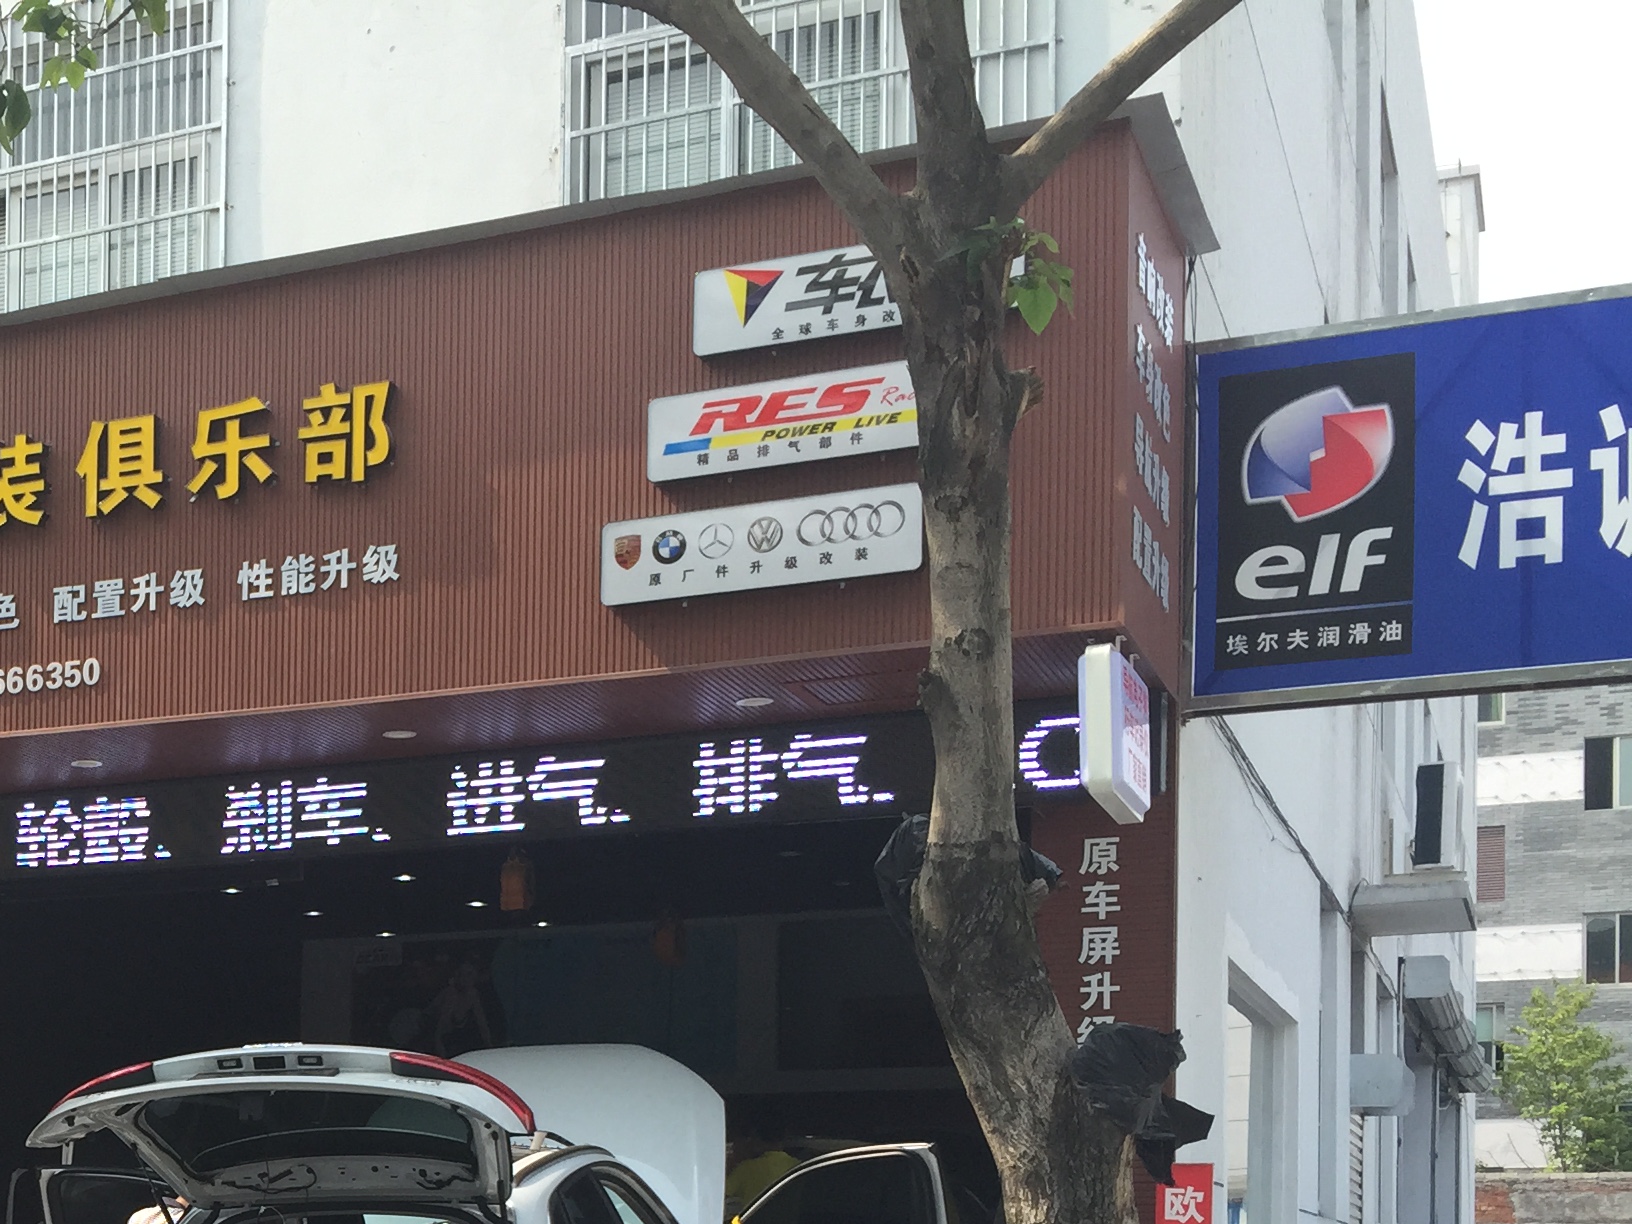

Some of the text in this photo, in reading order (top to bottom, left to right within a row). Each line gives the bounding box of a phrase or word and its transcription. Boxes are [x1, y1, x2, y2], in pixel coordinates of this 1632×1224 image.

[688, 376, 886, 437] RES
[760, 411, 903, 442] POWER LIVE
[696, 432, 864, 466] 精品排气部件
[648, 547, 869, 587] 原厂件升级改装
[1234, 526, 1393, 600] elf
[52, 568, 204, 624] 配置升级
[237, 543, 401, 602] 性能升级
[1226, 619, 1403, 656] 埃尔夫润滑油
